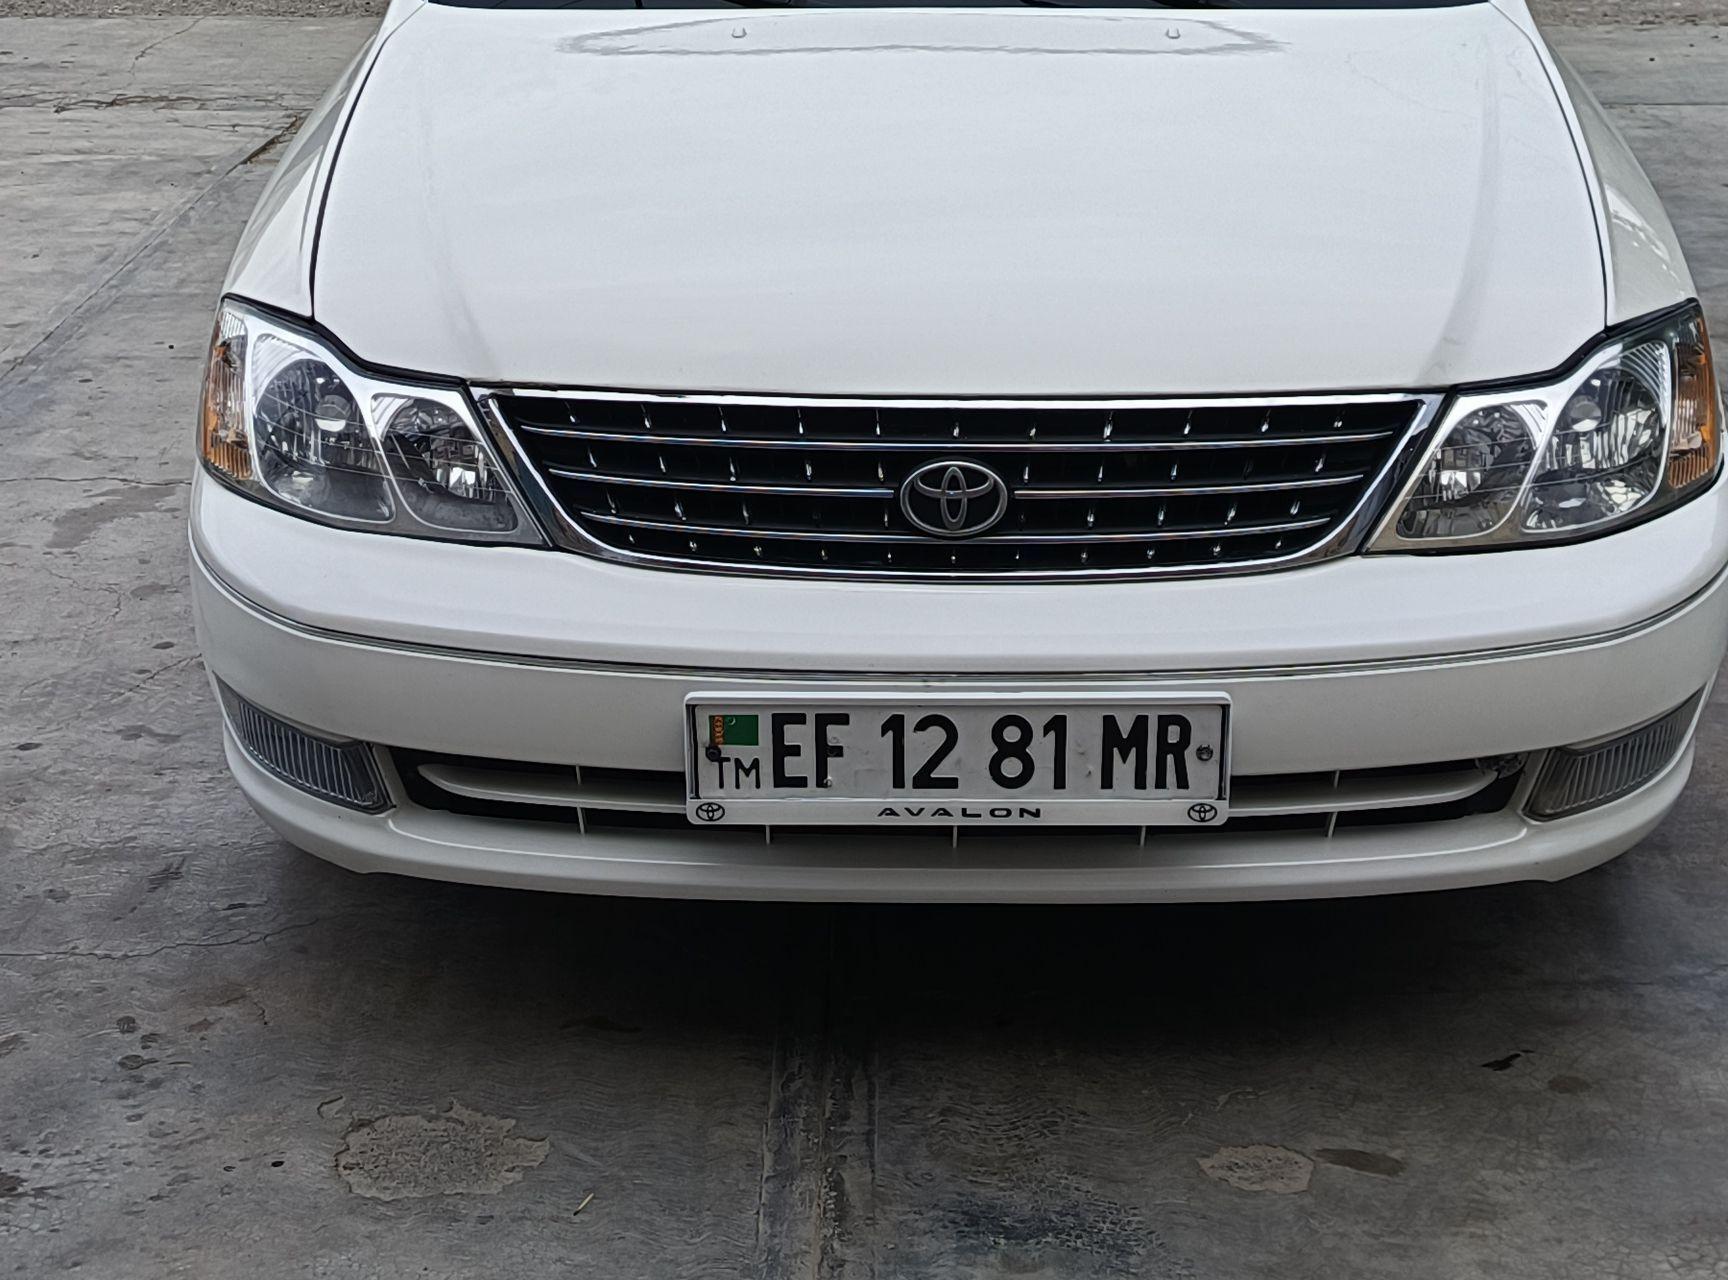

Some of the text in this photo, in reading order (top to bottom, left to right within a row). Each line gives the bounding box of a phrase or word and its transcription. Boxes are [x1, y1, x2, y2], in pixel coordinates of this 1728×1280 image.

[771, 713, 1192, 790] EF 12 81 MR
[714, 756, 761, 790] TM
[876, 807, 1042, 819] AVALON
